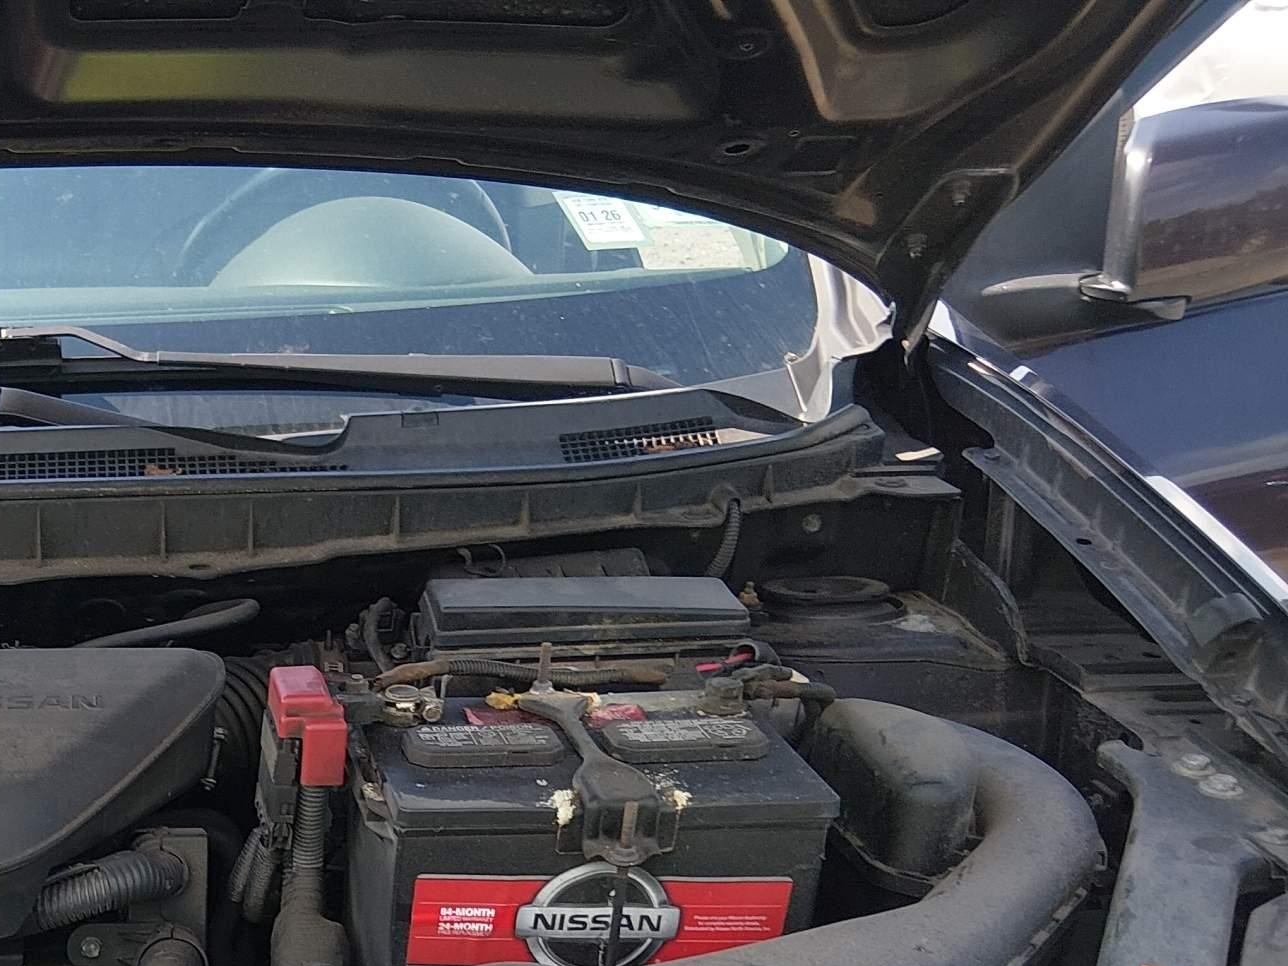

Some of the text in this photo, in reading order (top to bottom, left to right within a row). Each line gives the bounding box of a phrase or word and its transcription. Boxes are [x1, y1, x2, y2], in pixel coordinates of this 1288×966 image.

[578, 209, 621, 222] 01 26
[532, 913, 662, 932] NISSAN
